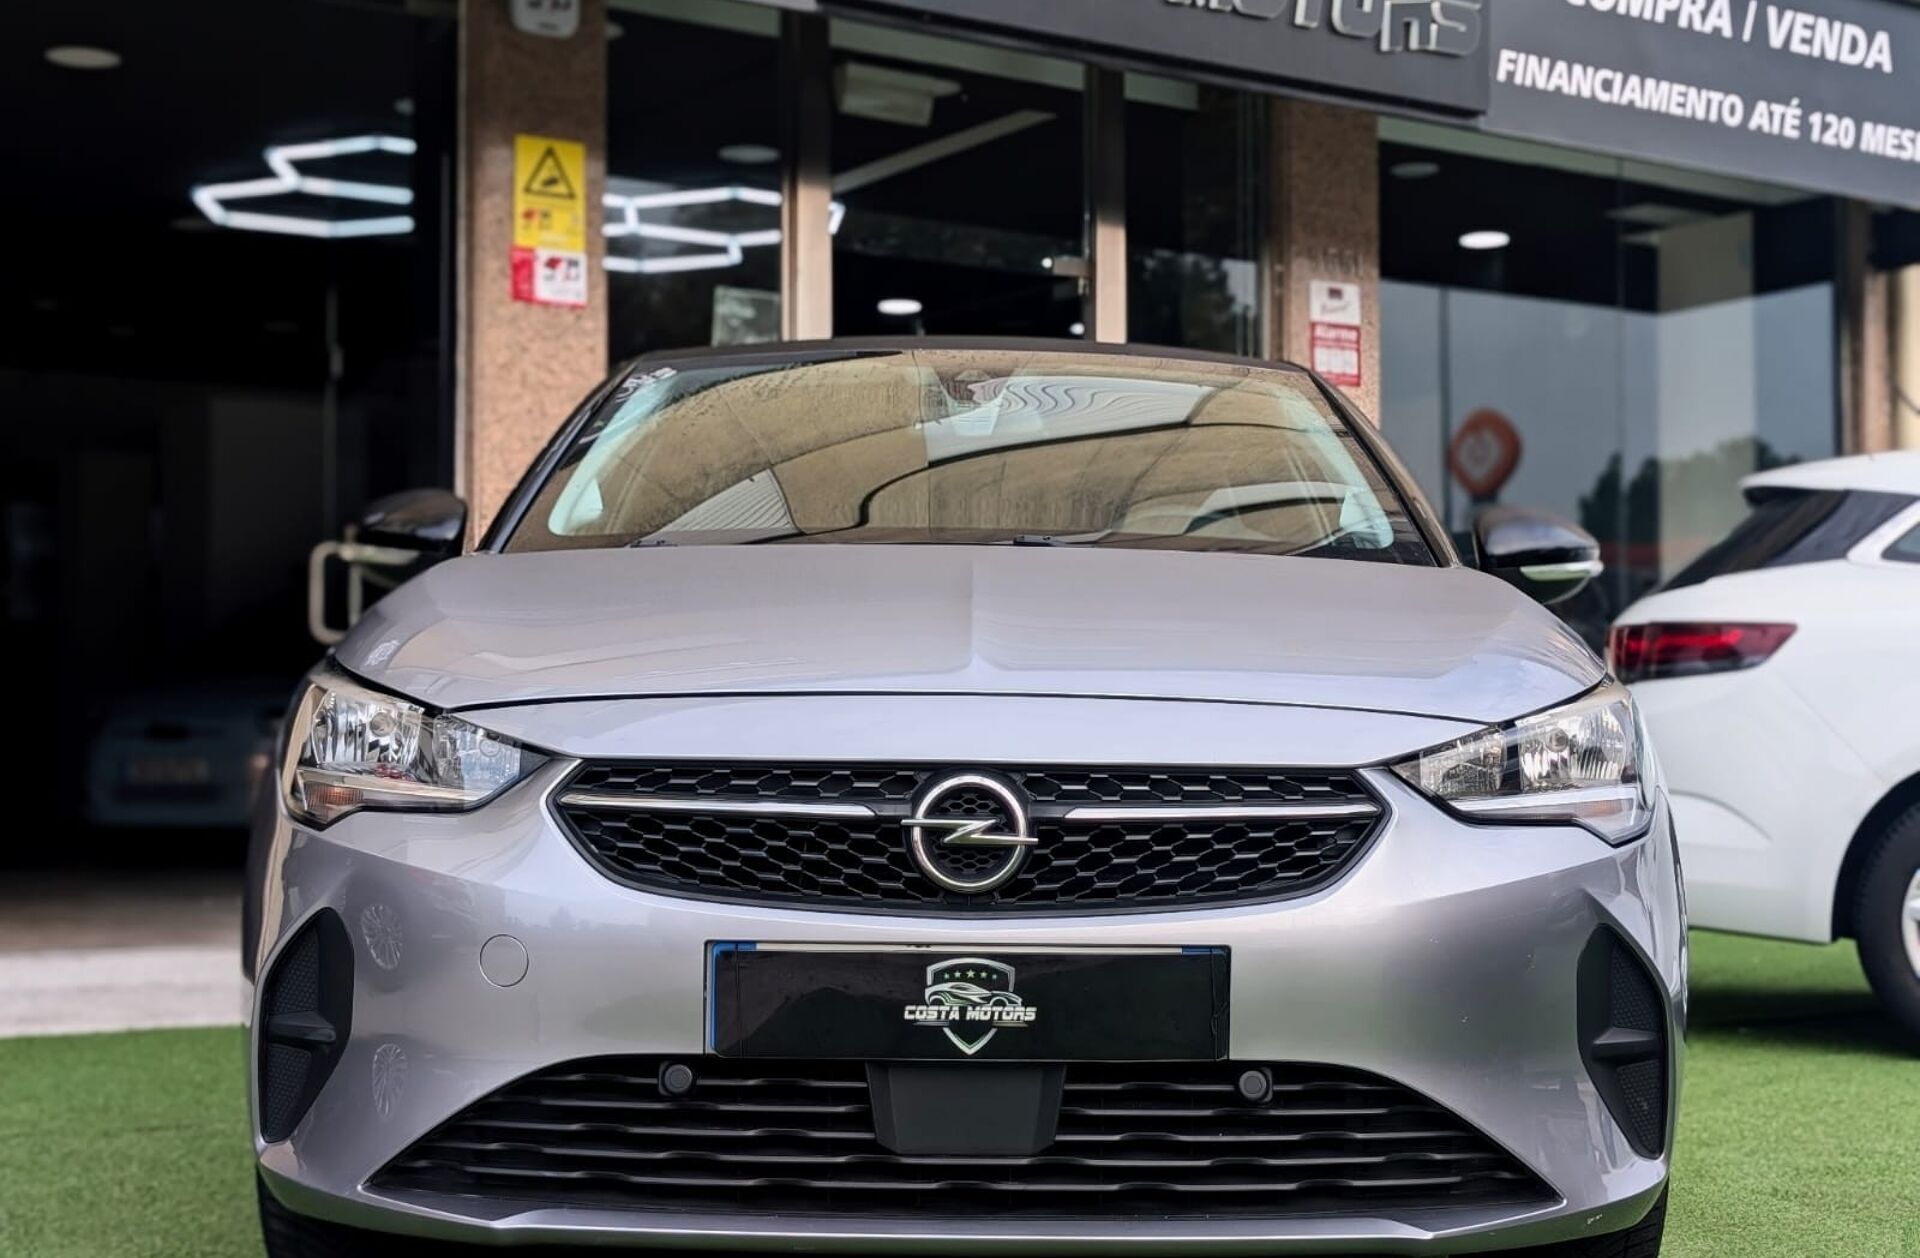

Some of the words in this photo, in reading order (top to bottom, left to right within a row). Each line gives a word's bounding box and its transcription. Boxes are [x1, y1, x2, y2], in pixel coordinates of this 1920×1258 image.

[1164, 0, 1483, 56] ORS
[1566, 0, 1733, 39] PRA
[1766, 5, 1894, 74] VENDA
[1496, 48, 1744, 128] FINANCIAMENTO
[1748, 97, 1803, 139] ATÉ
[1808, 110, 1856, 150] 120
[904, 1005, 960, 1021] COSTA
[965, 1006, 1037, 1021] MOTORS
